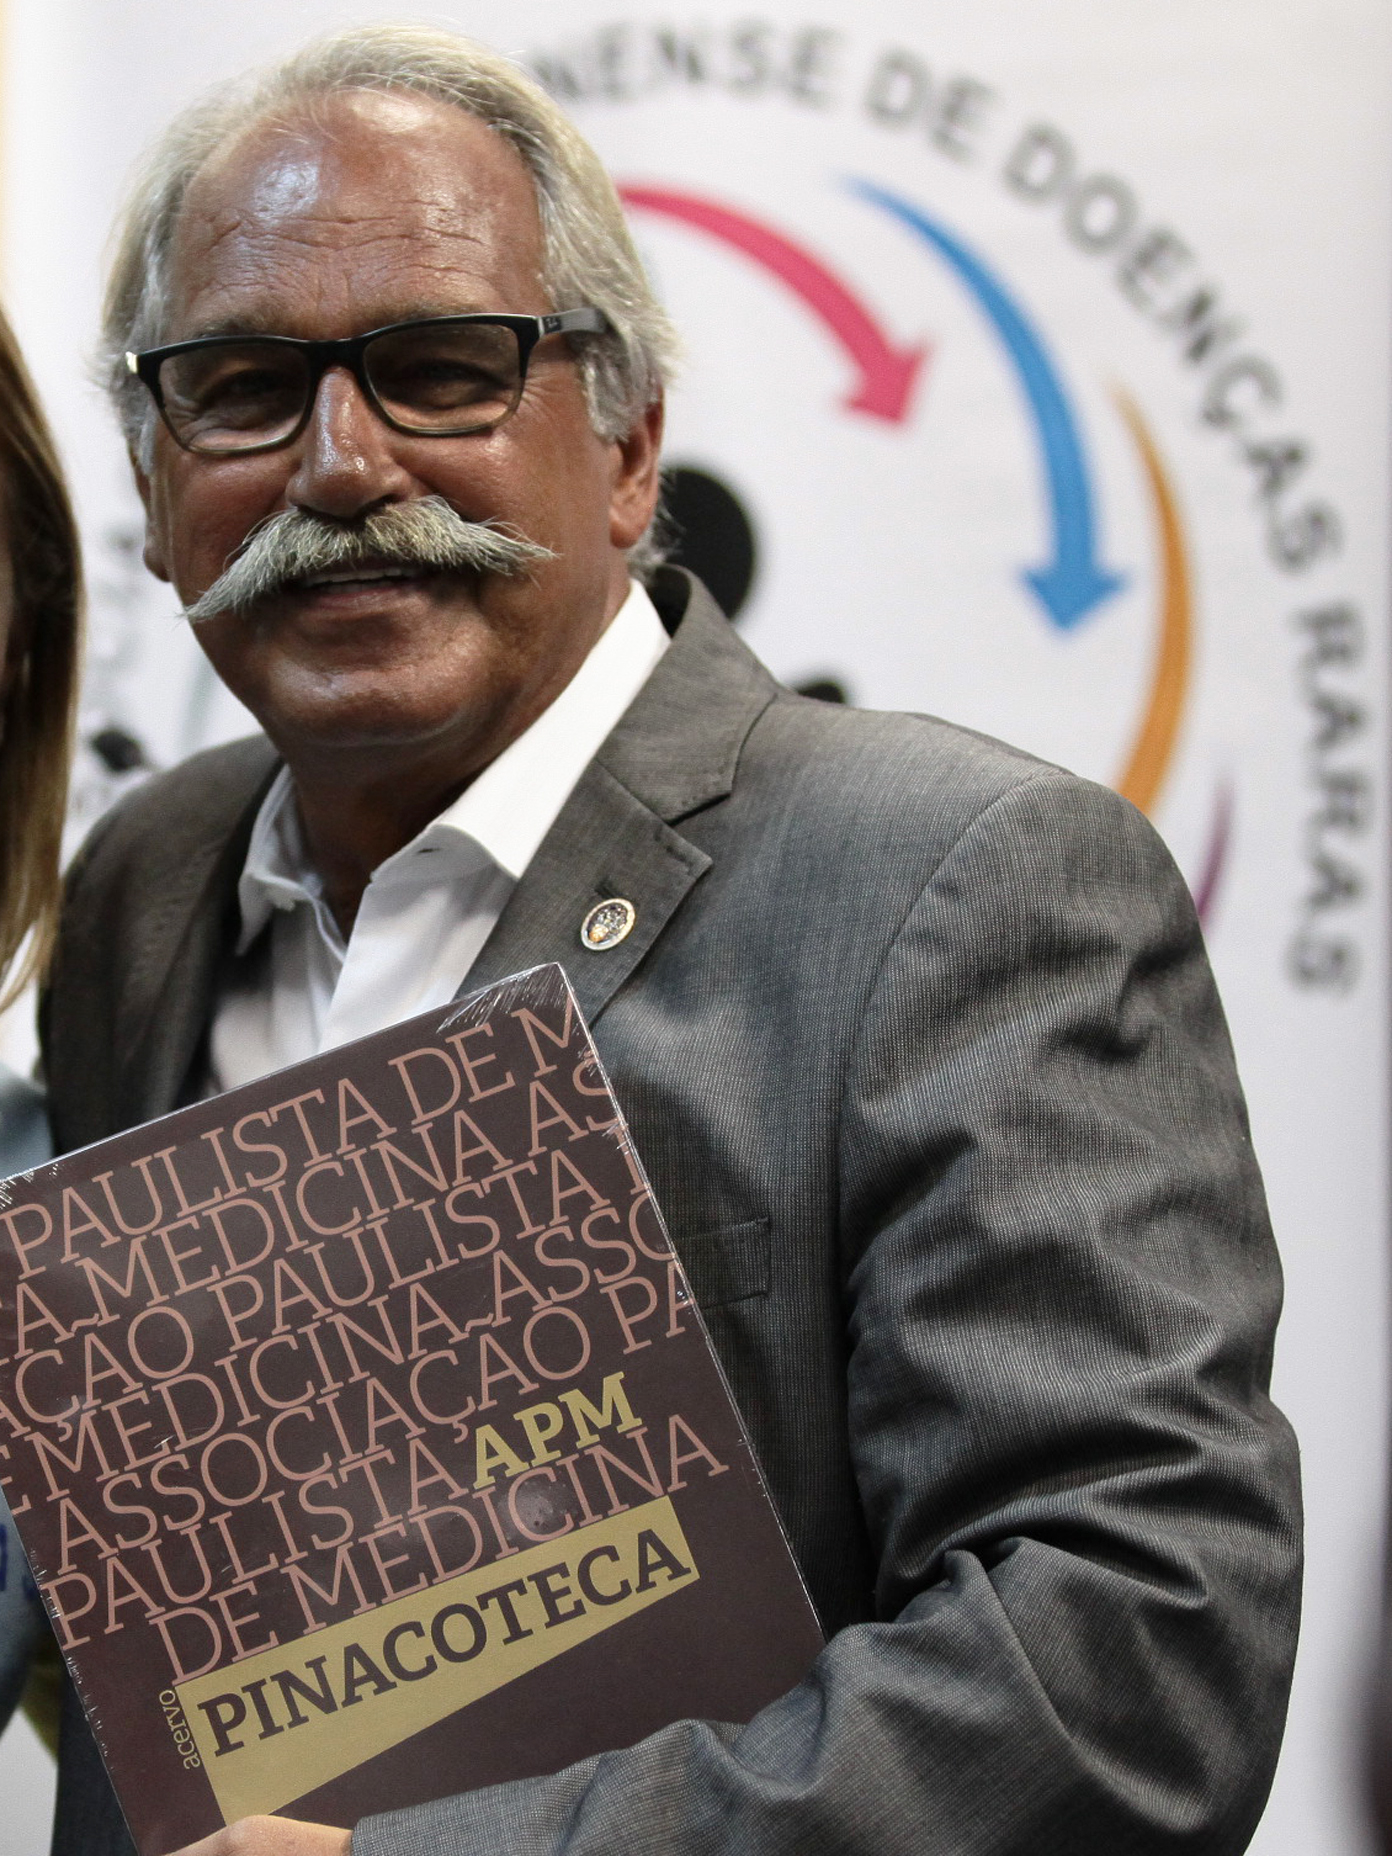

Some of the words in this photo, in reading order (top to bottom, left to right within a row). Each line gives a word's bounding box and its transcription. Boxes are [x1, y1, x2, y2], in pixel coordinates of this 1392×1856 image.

[862, 46, 1000, 166] DE
[1004, 120, 1346, 578] DOENÇAS
[1286, 604, 1374, 995] RARAS
[74, 1109, 514, 1328] MEDICINA
[527, 1048, 621, 1157] AS
[387, 1021, 516, 1126] DE
[207, 1148, 612, 1353] PAULISTA
[23, 1282, 470, 1502] MEDICINA
[39, 1440, 476, 1651] PAULISTA
[470, 1371, 643, 1491] APM
[57, 1306, 591, 1576] ASSOCIAÇÃO
[148, 1580, 280, 1687] DE
[281, 1414, 730, 1636] MEDICINA
[196, 1527, 694, 1758] PINACOTECA
[158, 1688, 201, 1771] acervo
